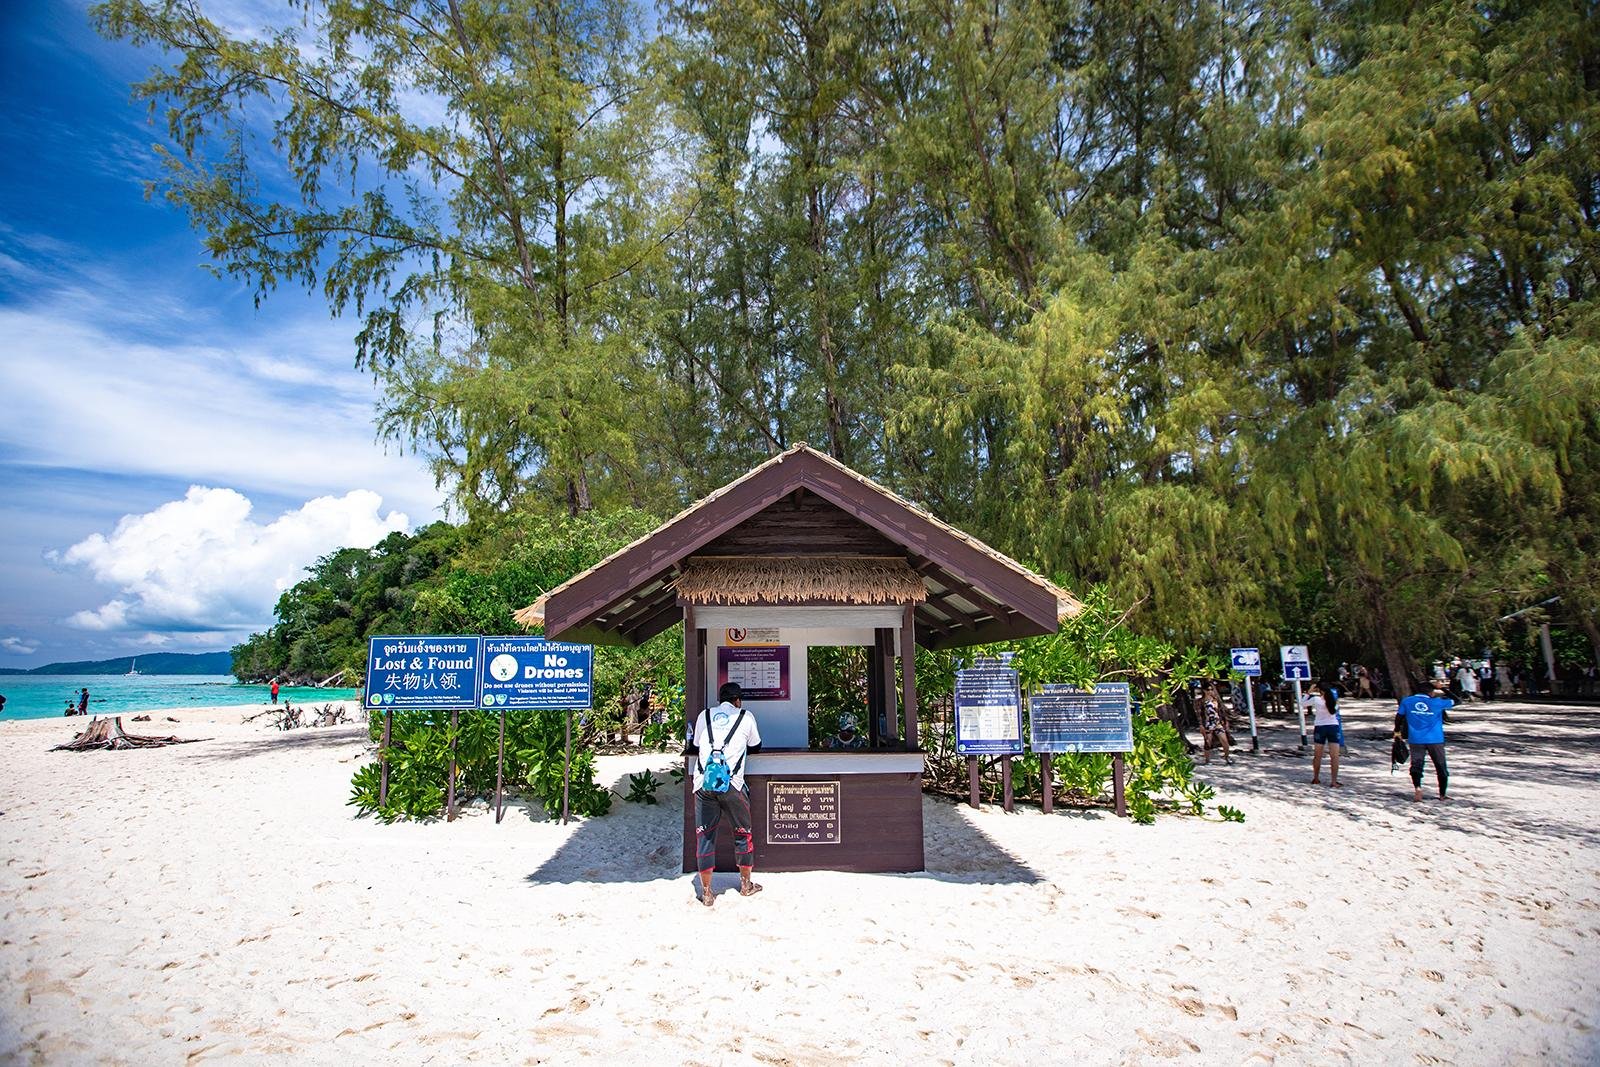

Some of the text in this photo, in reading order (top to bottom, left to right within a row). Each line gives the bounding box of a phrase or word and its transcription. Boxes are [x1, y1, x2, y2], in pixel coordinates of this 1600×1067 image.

[384, 640, 467, 657] จุดรับแจ้งของหาย
[374, 656, 473, 670] Lost & Found
[544, 654, 568, 667] No
[524, 666, 584, 679] Drones
